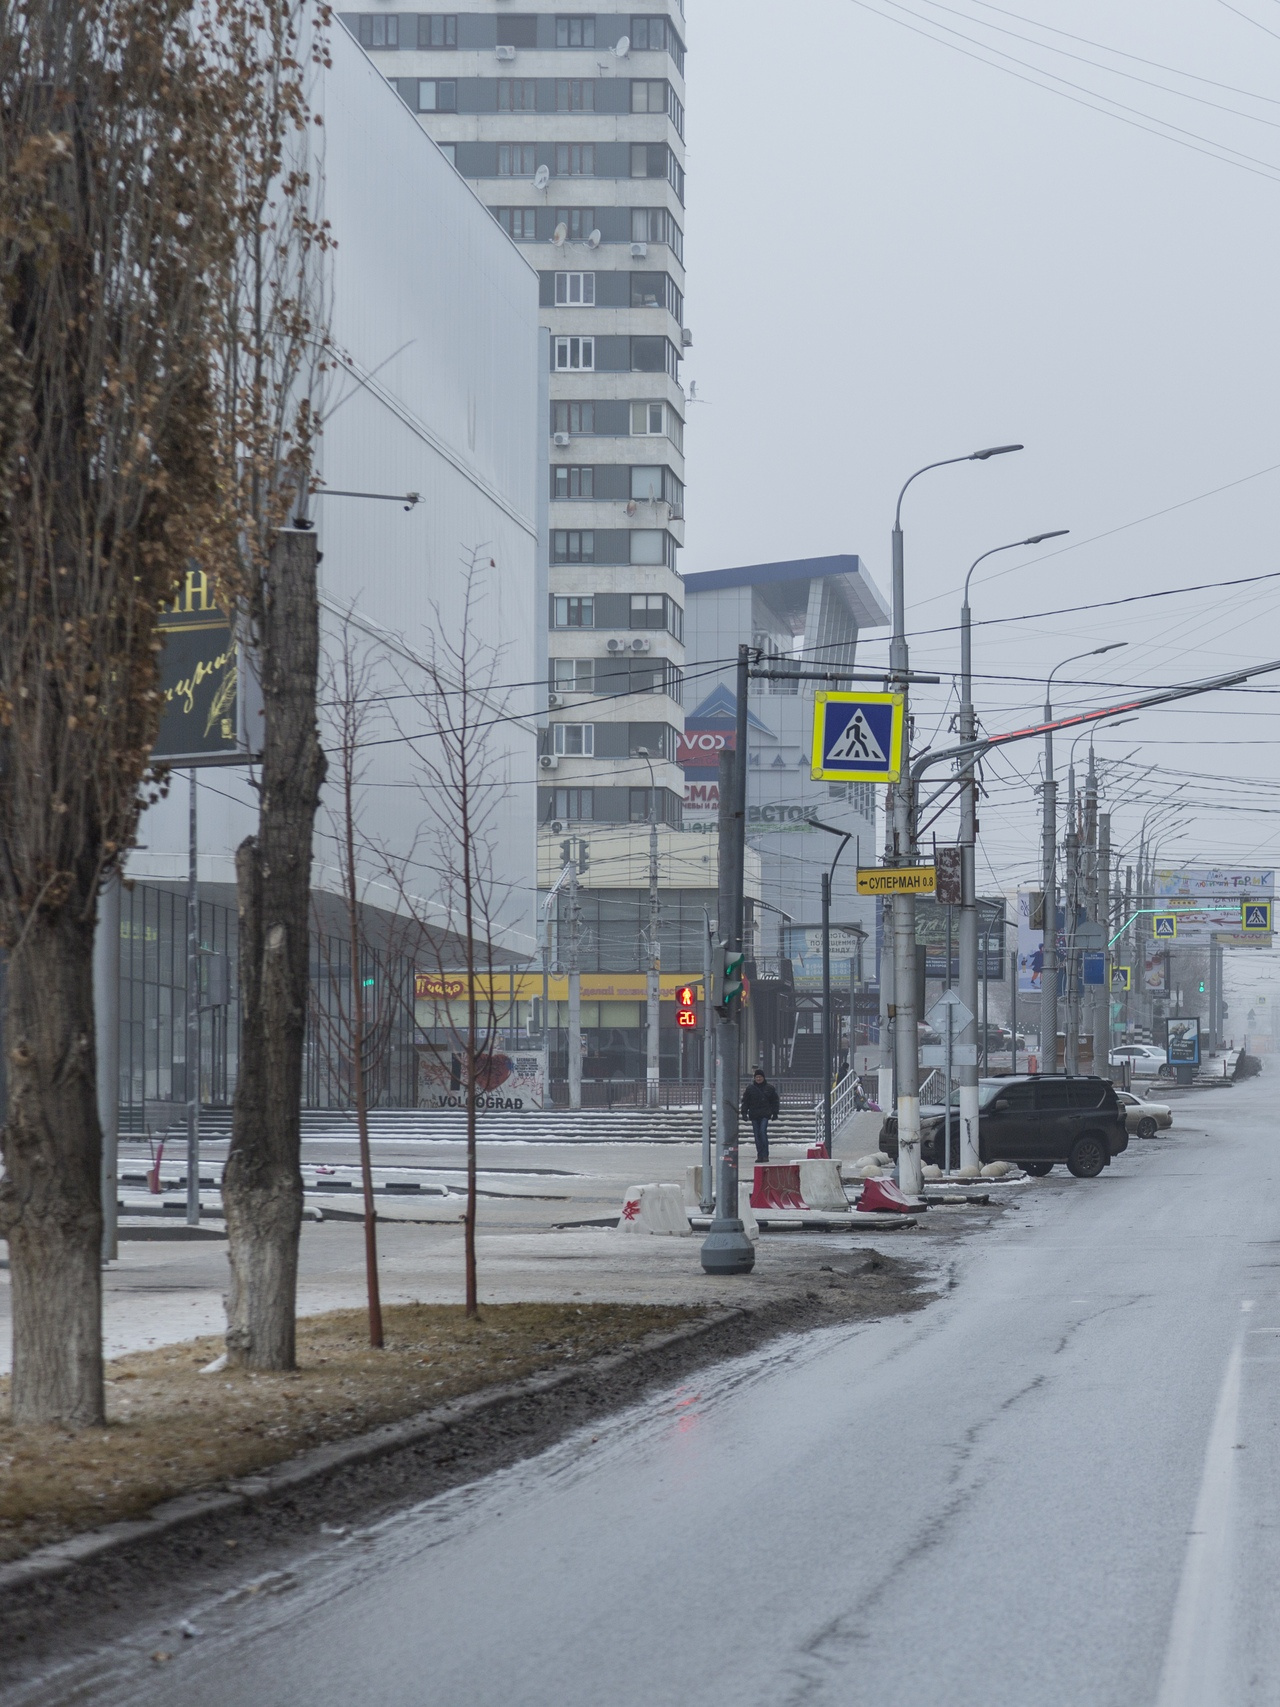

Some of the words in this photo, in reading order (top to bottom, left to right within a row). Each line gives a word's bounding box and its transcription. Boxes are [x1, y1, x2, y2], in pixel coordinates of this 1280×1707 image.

[869, 876, 920, 889] СУПЕРМАН
[922, 877, 934, 887] 0.8
[679, 1011, 695, 1025] 20
[438, 1095, 524, 1110] VOLOGRAD
